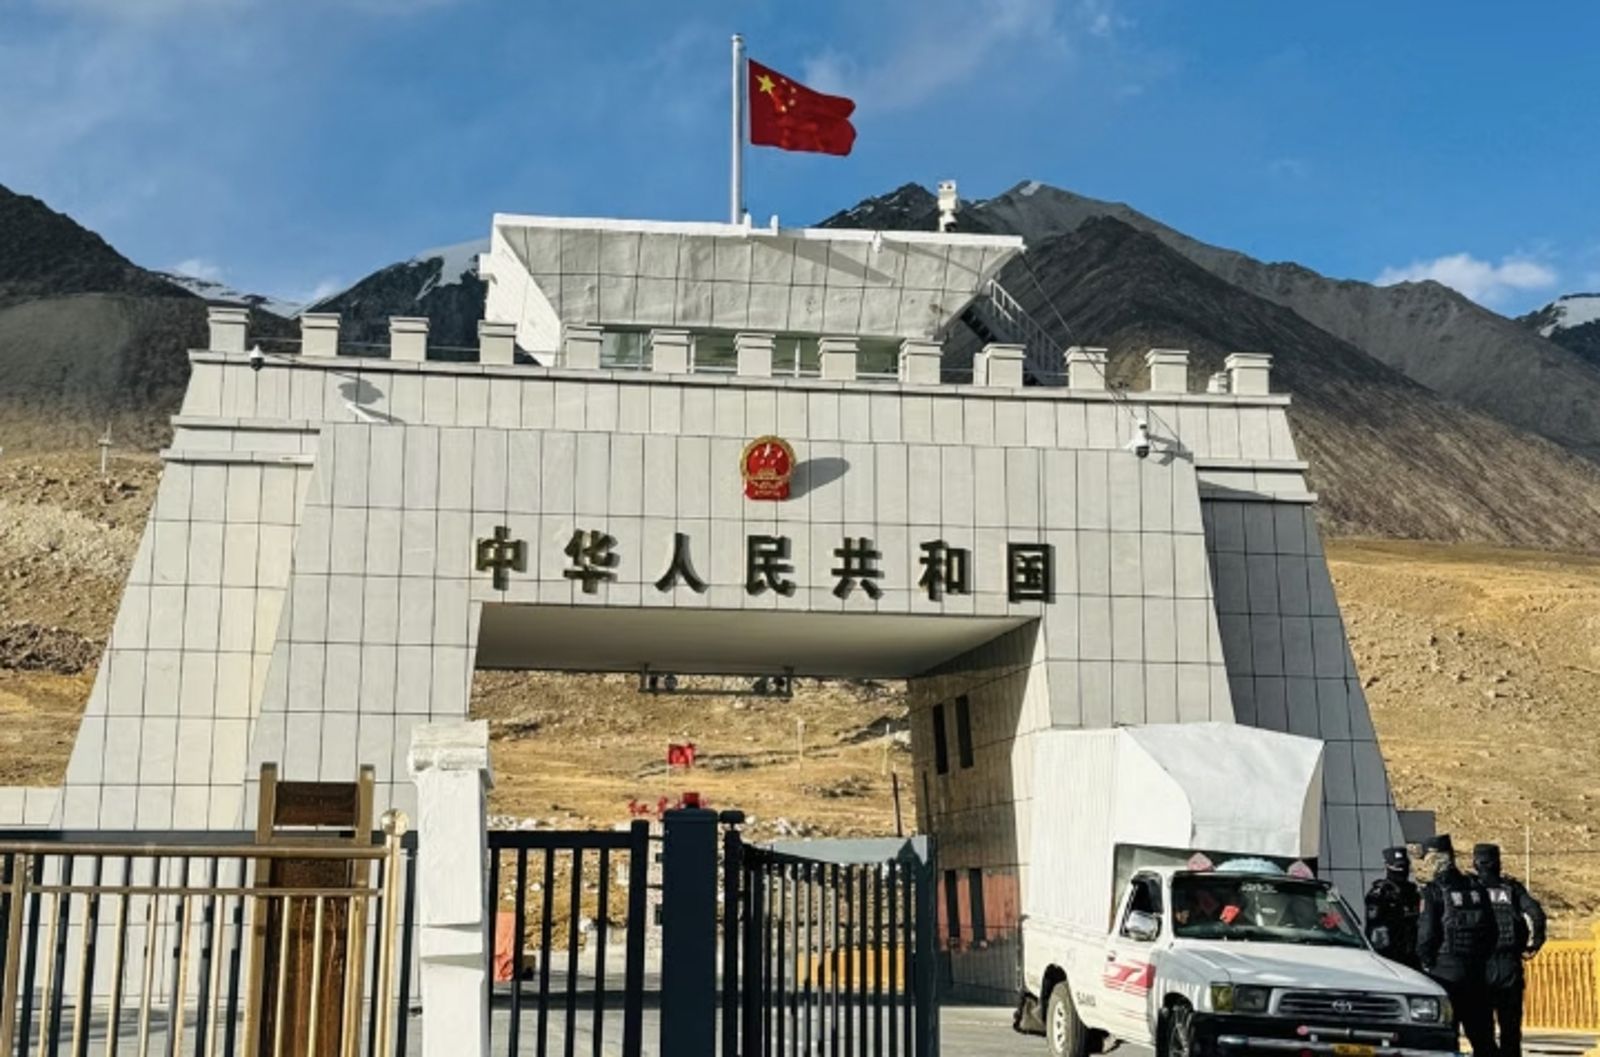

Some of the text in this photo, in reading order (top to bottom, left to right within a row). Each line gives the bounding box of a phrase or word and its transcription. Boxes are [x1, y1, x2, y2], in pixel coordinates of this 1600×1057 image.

[475, 526, 1054, 603] 中华人民共和国
